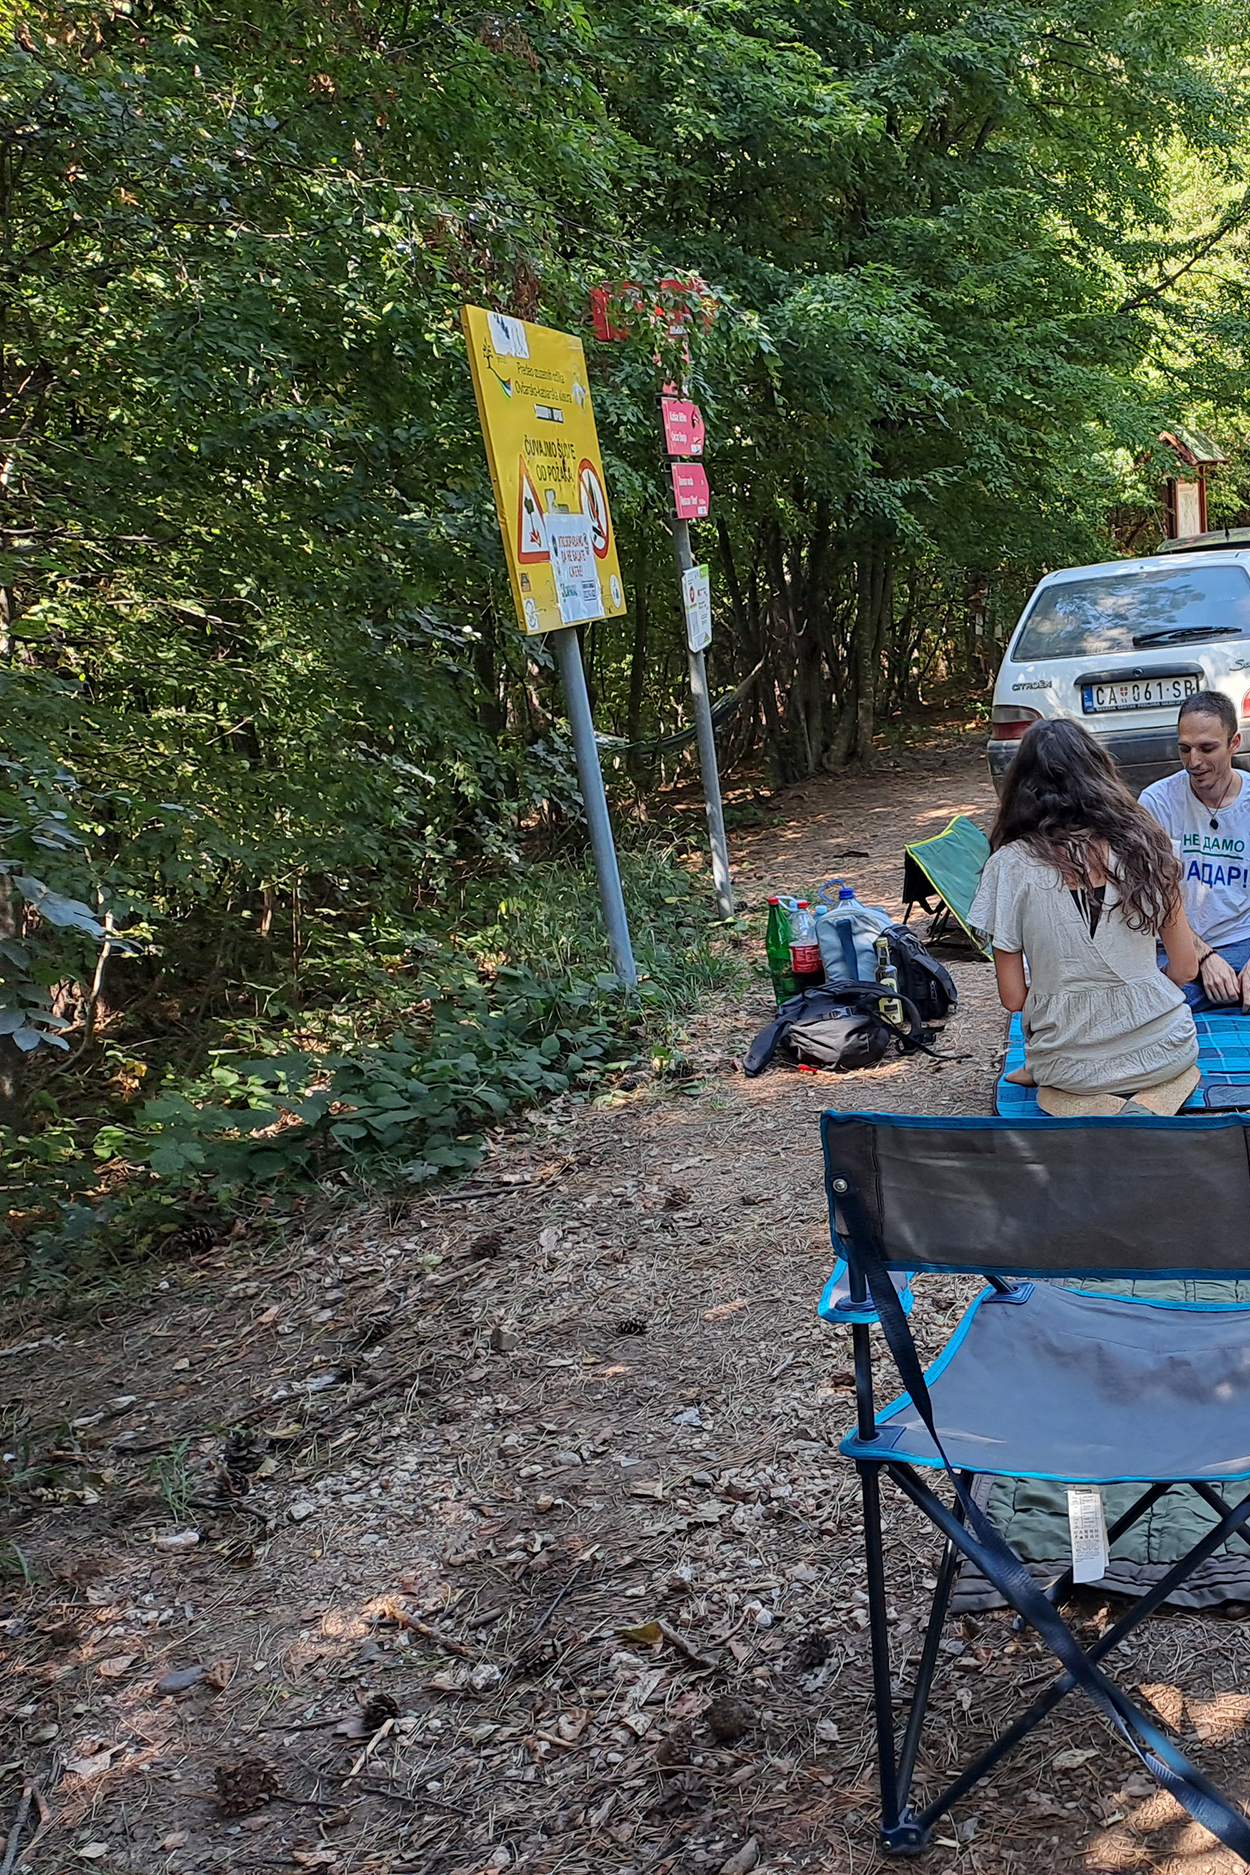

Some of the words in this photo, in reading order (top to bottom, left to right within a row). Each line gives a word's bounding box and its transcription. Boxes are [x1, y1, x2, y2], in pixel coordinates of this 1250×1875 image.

[524, 434, 557, 458] ČUVAJMO
[536, 464, 547, 481] OD
[1096, 686, 1117, 705] ČA
[1184, 833, 1200, 846] НЕ
[1203, 836, 1245, 852] ДАМО
